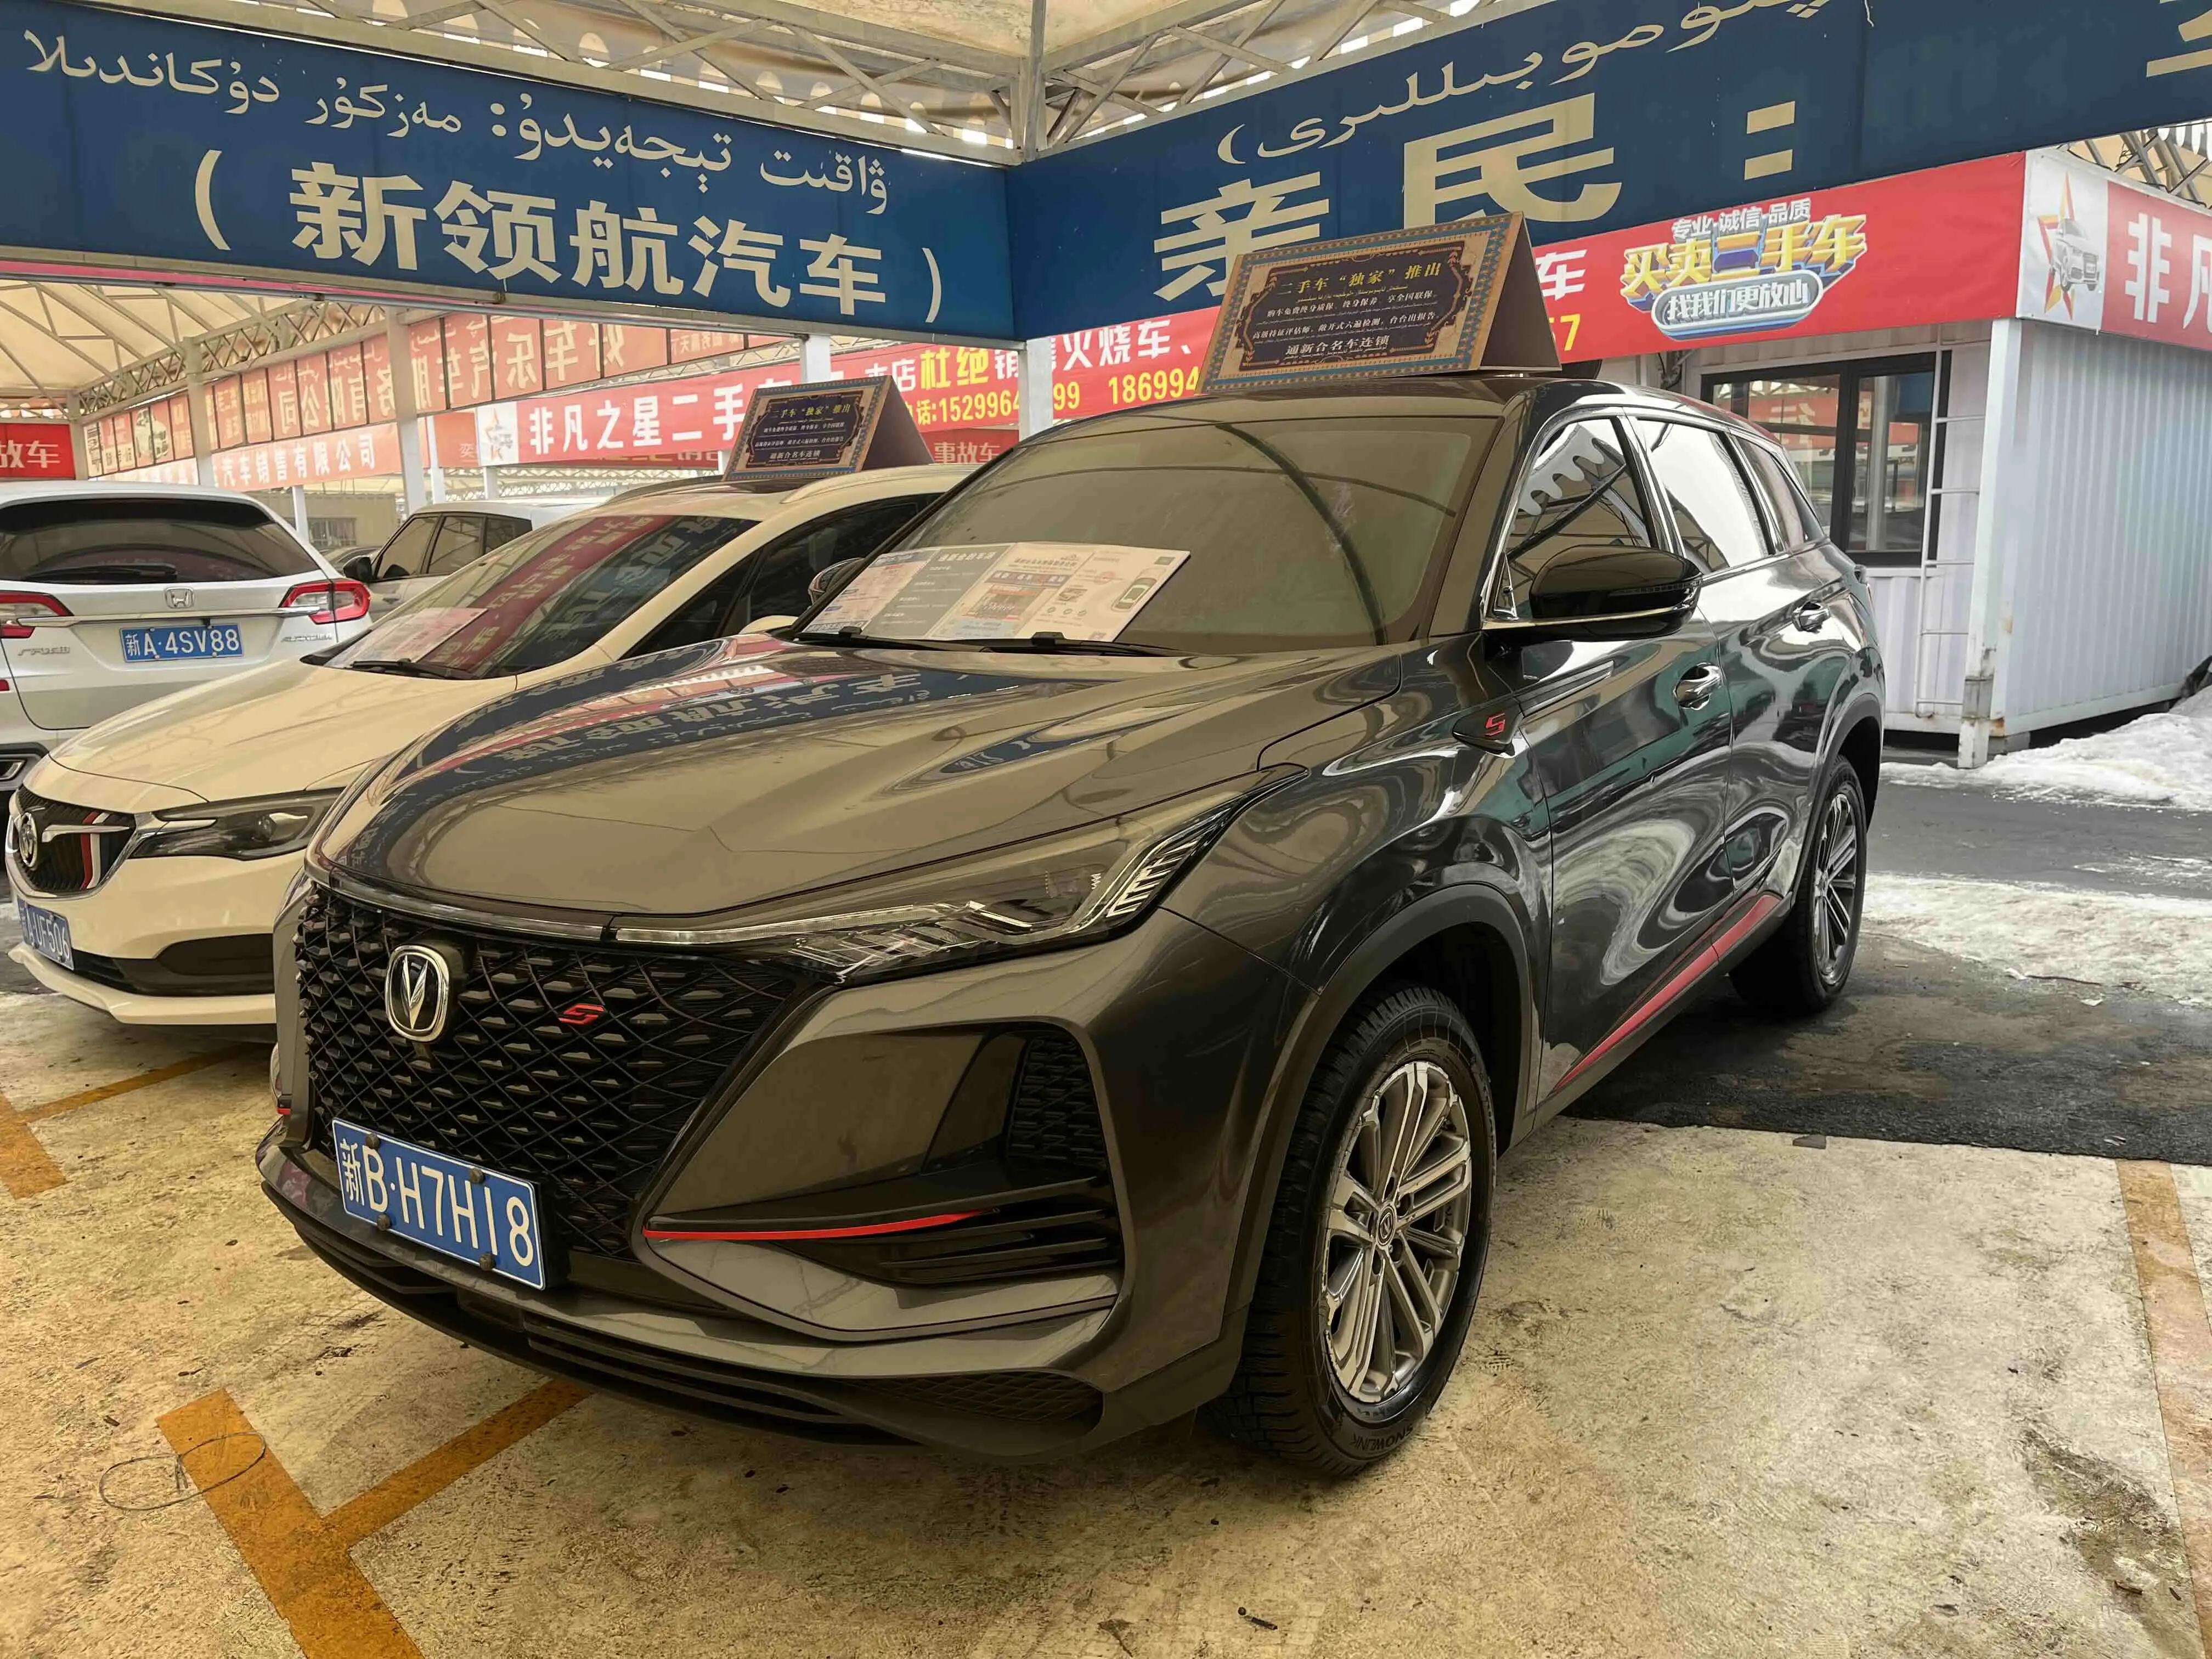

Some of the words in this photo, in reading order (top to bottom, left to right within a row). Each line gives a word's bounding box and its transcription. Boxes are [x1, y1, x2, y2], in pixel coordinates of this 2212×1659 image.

[1621, 215, 1867, 301] 买卖二手车
[1277, 277, 1329, 295] 二手车
[1404, 262, 1442, 279] 推出
[1667, 278, 1810, 324] 找我们更放心
[0, 439, 61, 469] 故车
